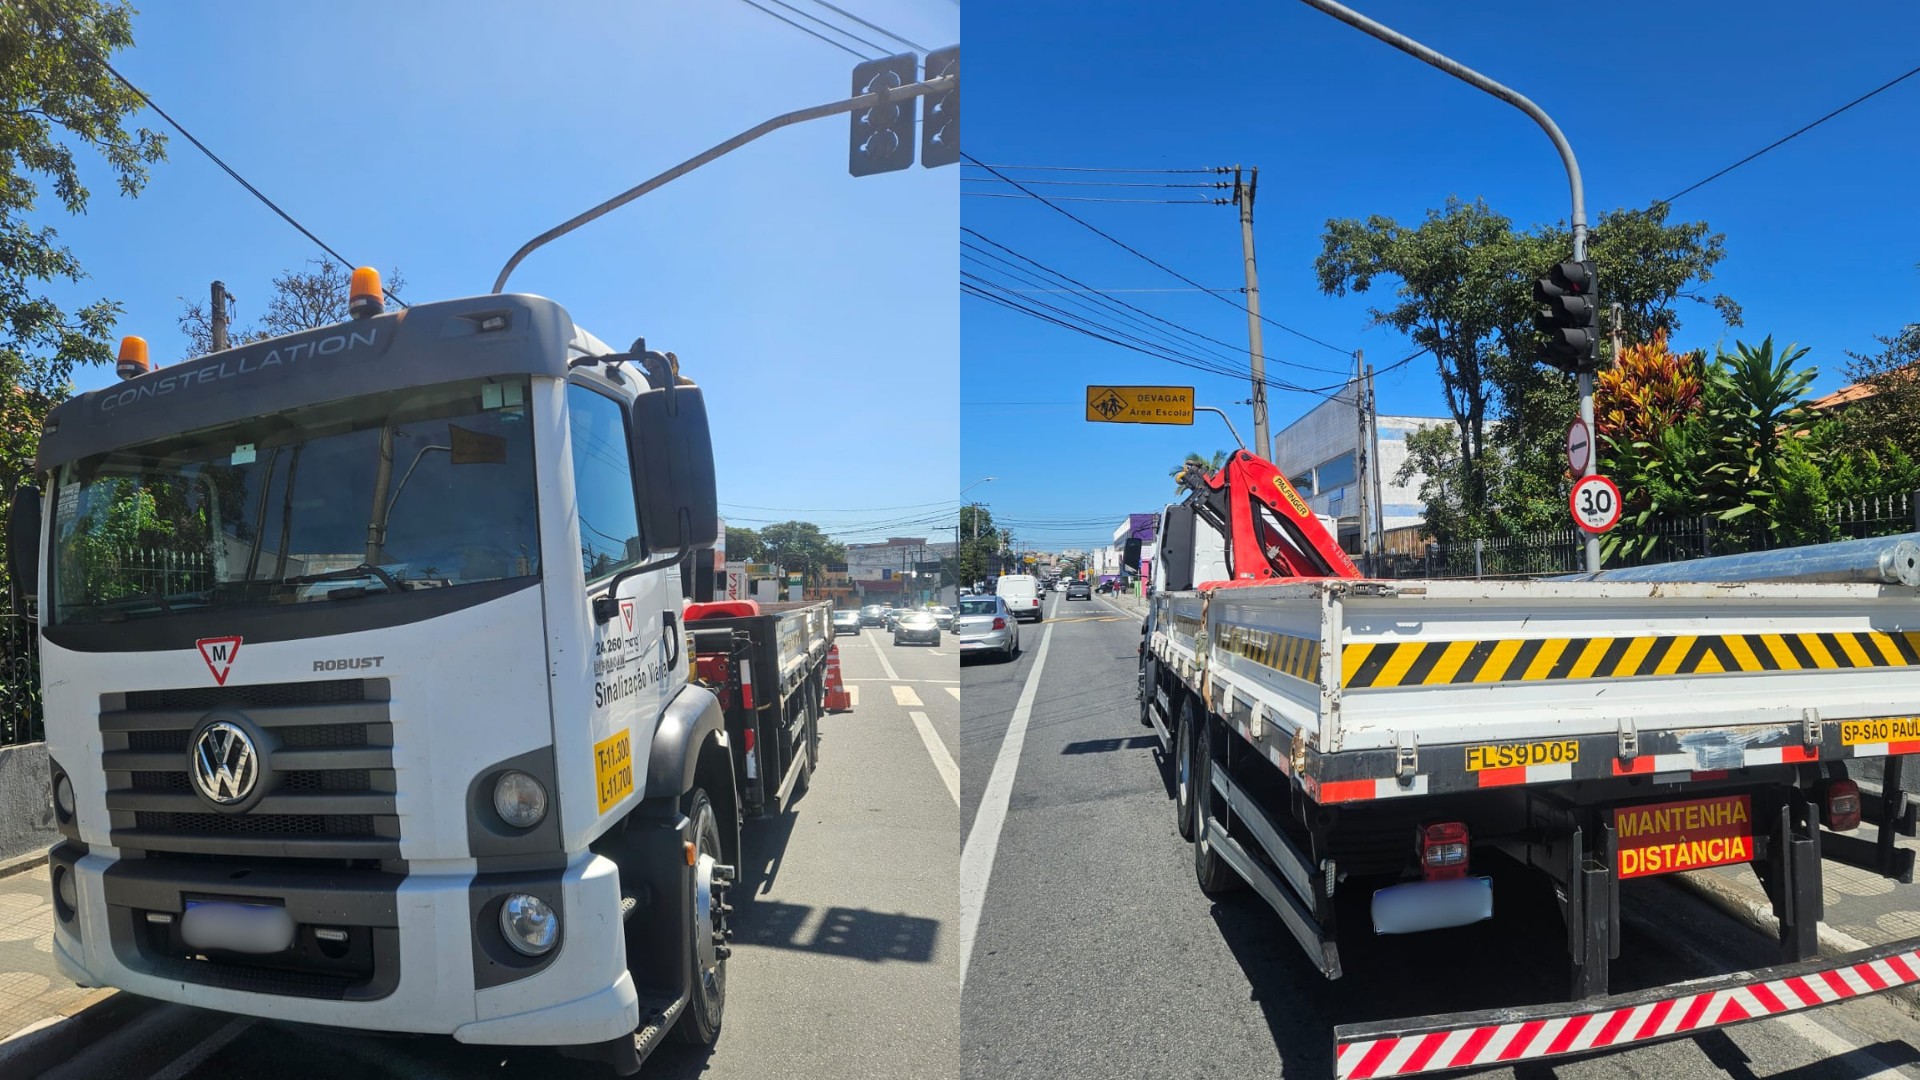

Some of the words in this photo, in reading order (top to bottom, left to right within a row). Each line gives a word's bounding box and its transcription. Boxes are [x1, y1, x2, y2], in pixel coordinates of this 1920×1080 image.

[101, 328, 377, 412] CONSTELLATION
[1129, 407, 1152, 416] Área
[1155, 408, 1191, 417] Escolar
[1137, 394, 1186, 403] DEVAGAR
[1274, 477, 1308, 516] PALFINGER
[1581, 488, 1612, 513] 30
[212, 645, 227, 661] M
[595, 637, 622, 656] 24.260
[313, 656, 385, 672] ROBUST
[595, 667, 647, 709] Sinalização
[1844, 720, 1888, 741] SP-SÃO
[598, 737, 630, 773] T-11.300
[1466, 741, 1578, 770] FLS9D05
[601, 765, 632, 804] L-11.700
[1618, 800, 1748, 838] MANTENHA
[1622, 835, 1747, 875] DISTÂNCIA
